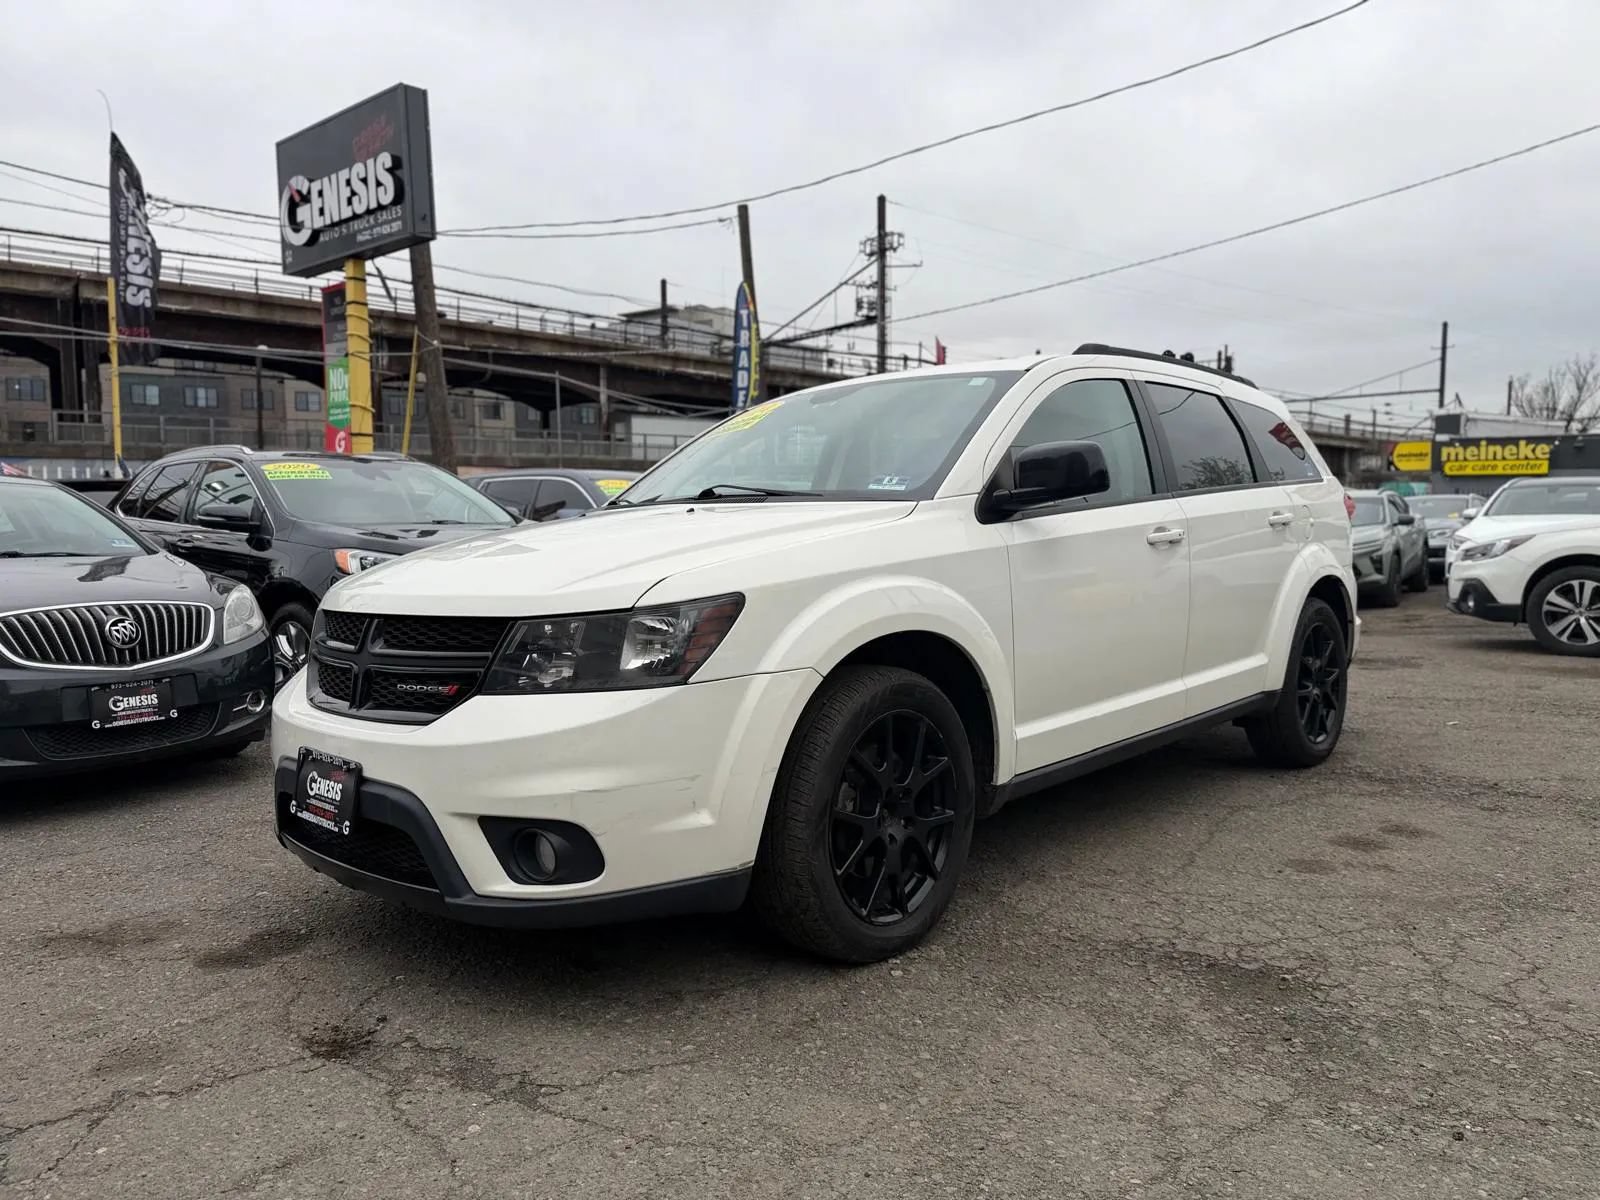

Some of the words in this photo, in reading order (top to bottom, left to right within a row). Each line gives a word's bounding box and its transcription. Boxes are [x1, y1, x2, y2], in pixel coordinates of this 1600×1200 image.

[280, 151, 395, 246] GENESIS
[319, 226, 341, 242] AUTO
[350, 213, 376, 234] TRUCK
[377, 204, 402, 222] SALES
[736, 308, 749, 408] TRADE
[335, 430, 346, 453] G
[1441, 440, 1551, 461] meineke
[1448, 463, 1468, 472] car
[1471, 462, 1498, 472] care
[1502, 460, 1543, 472] center
[397, 684, 449, 693] DODGE
[108, 693, 158, 711] GENESIS
[170, 709, 178, 718] G
[91, 720, 101, 729] G
[307, 770, 343, 801] GENESIS
[289, 800, 298, 814] G
[342, 820, 351, 835] G
